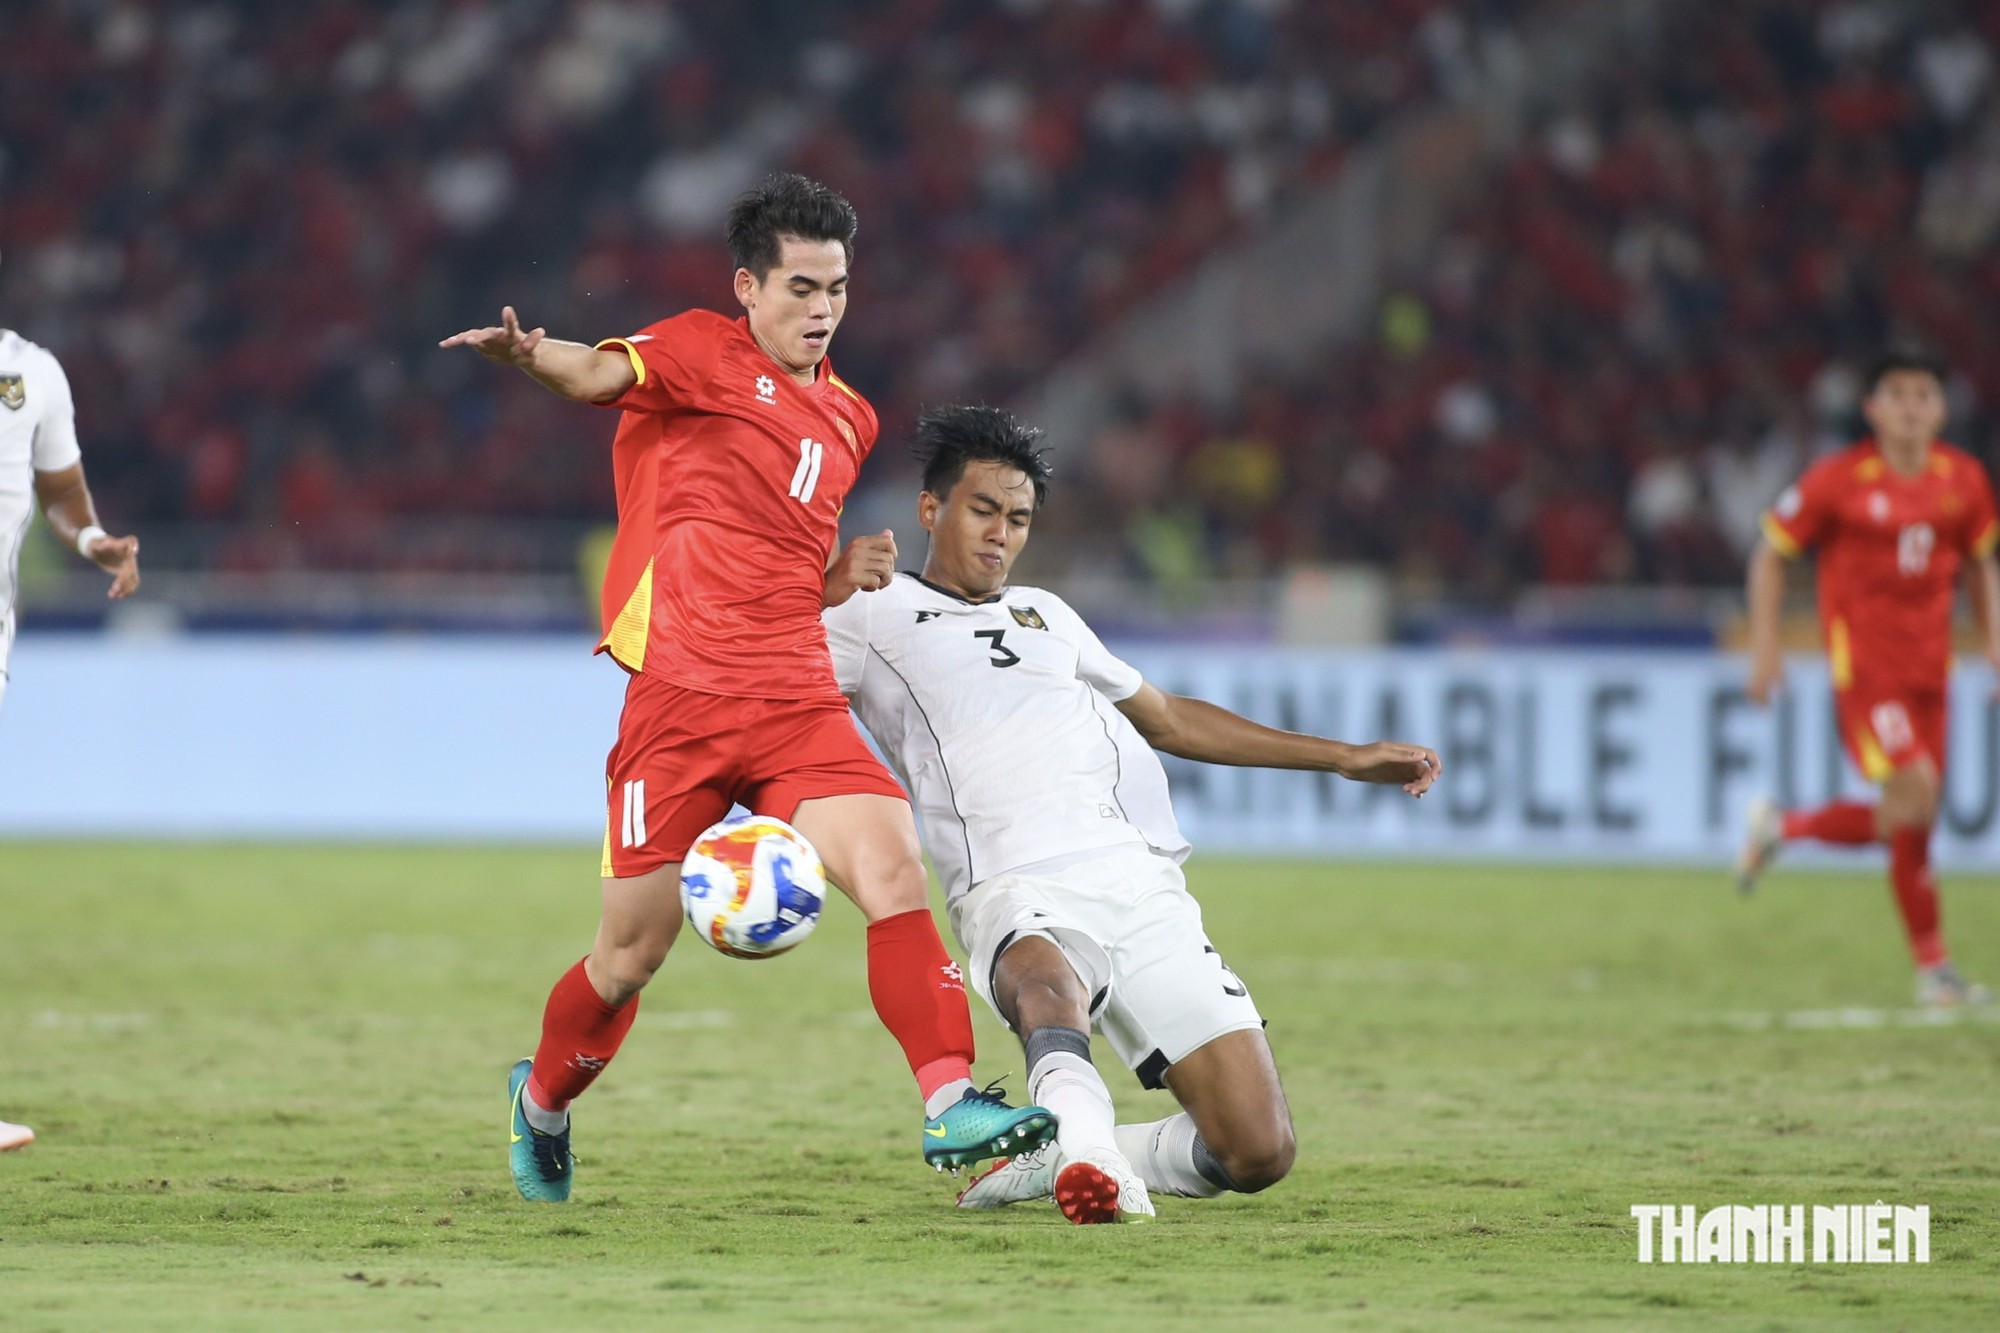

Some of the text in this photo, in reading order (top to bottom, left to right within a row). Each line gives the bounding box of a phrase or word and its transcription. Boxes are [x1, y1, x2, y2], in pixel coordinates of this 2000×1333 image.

[788, 438, 823, 503] 11
[974, 629, 1021, 668] 3
[622, 779, 647, 848] 11
